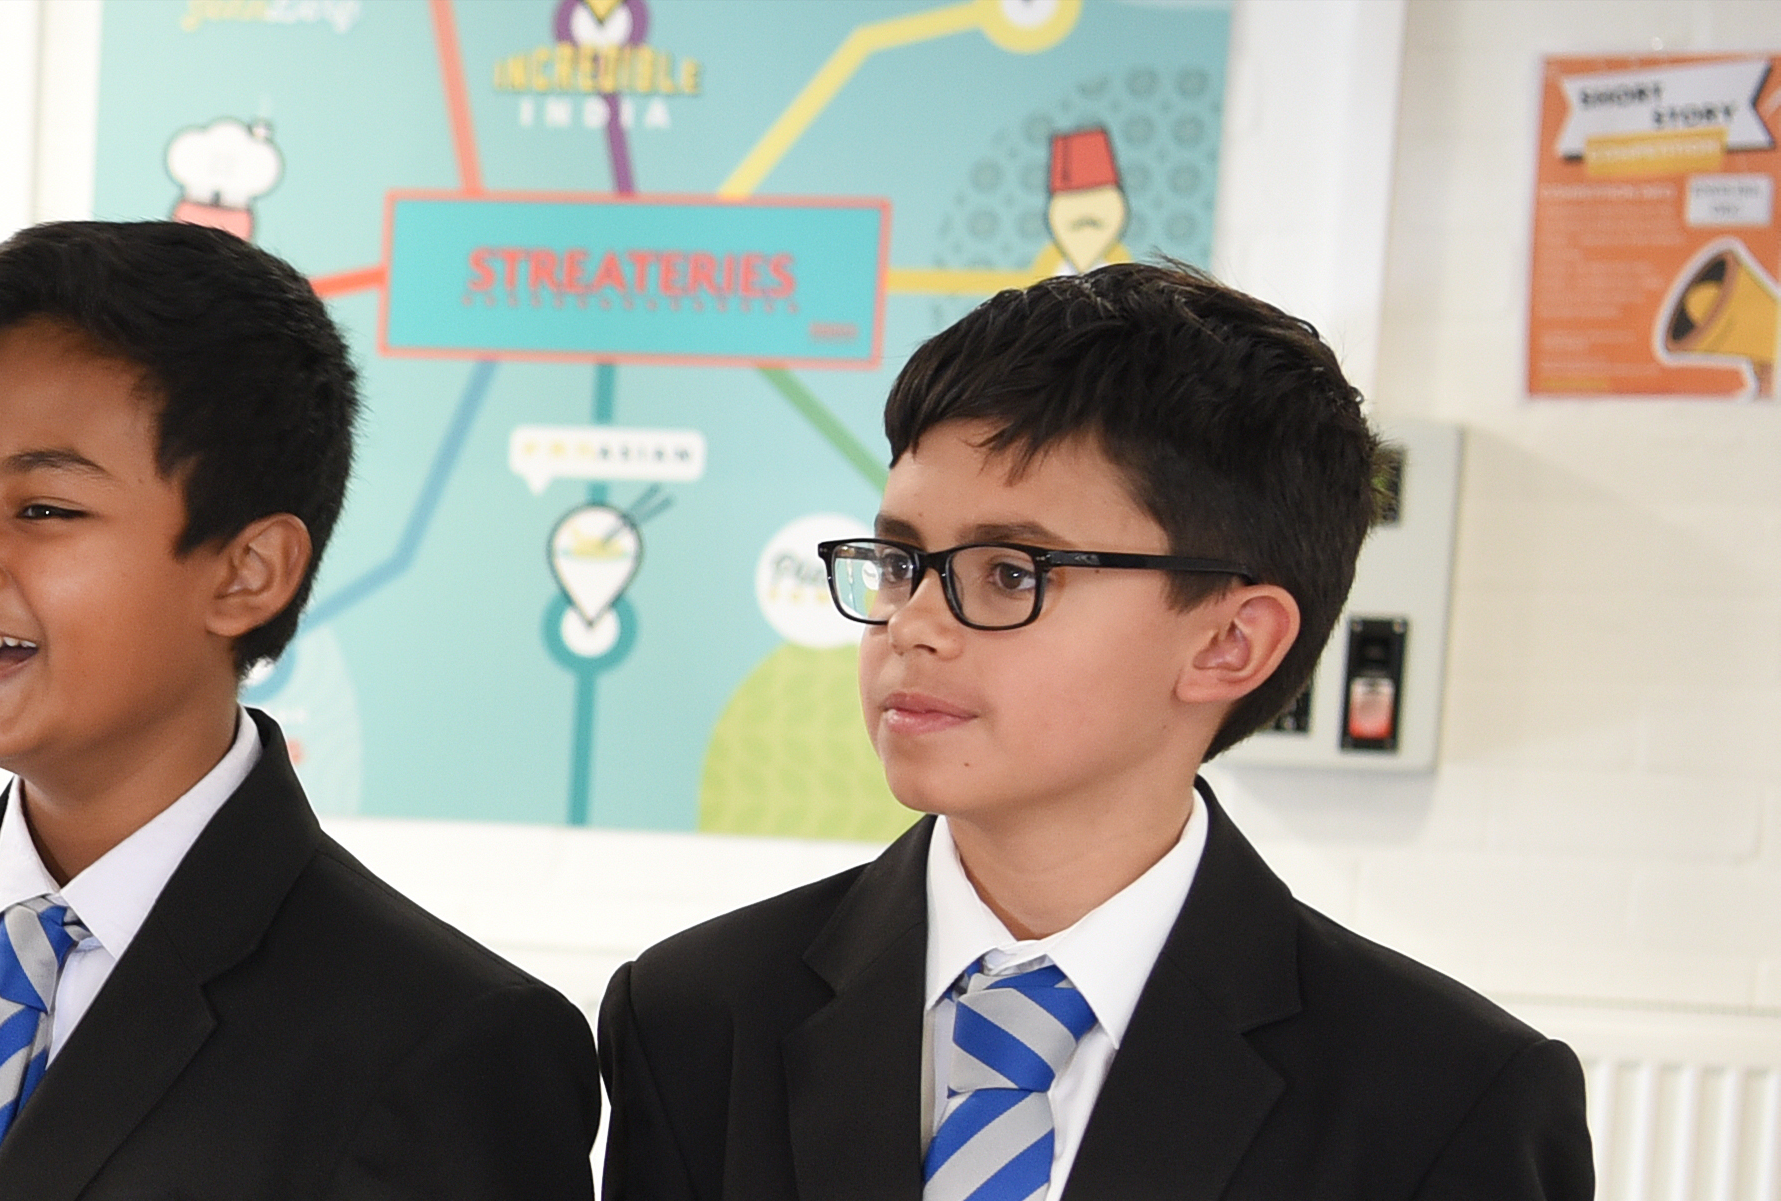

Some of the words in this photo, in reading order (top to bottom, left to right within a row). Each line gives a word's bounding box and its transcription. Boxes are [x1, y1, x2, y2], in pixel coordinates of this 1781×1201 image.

[494, 42, 702, 96] INCREDIBLE
[1579, 81, 1662, 110] SHORT
[519, 96, 672, 129] INDIA
[1651, 103, 1737, 130] STORY
[467, 246, 797, 299] STREATERIES
